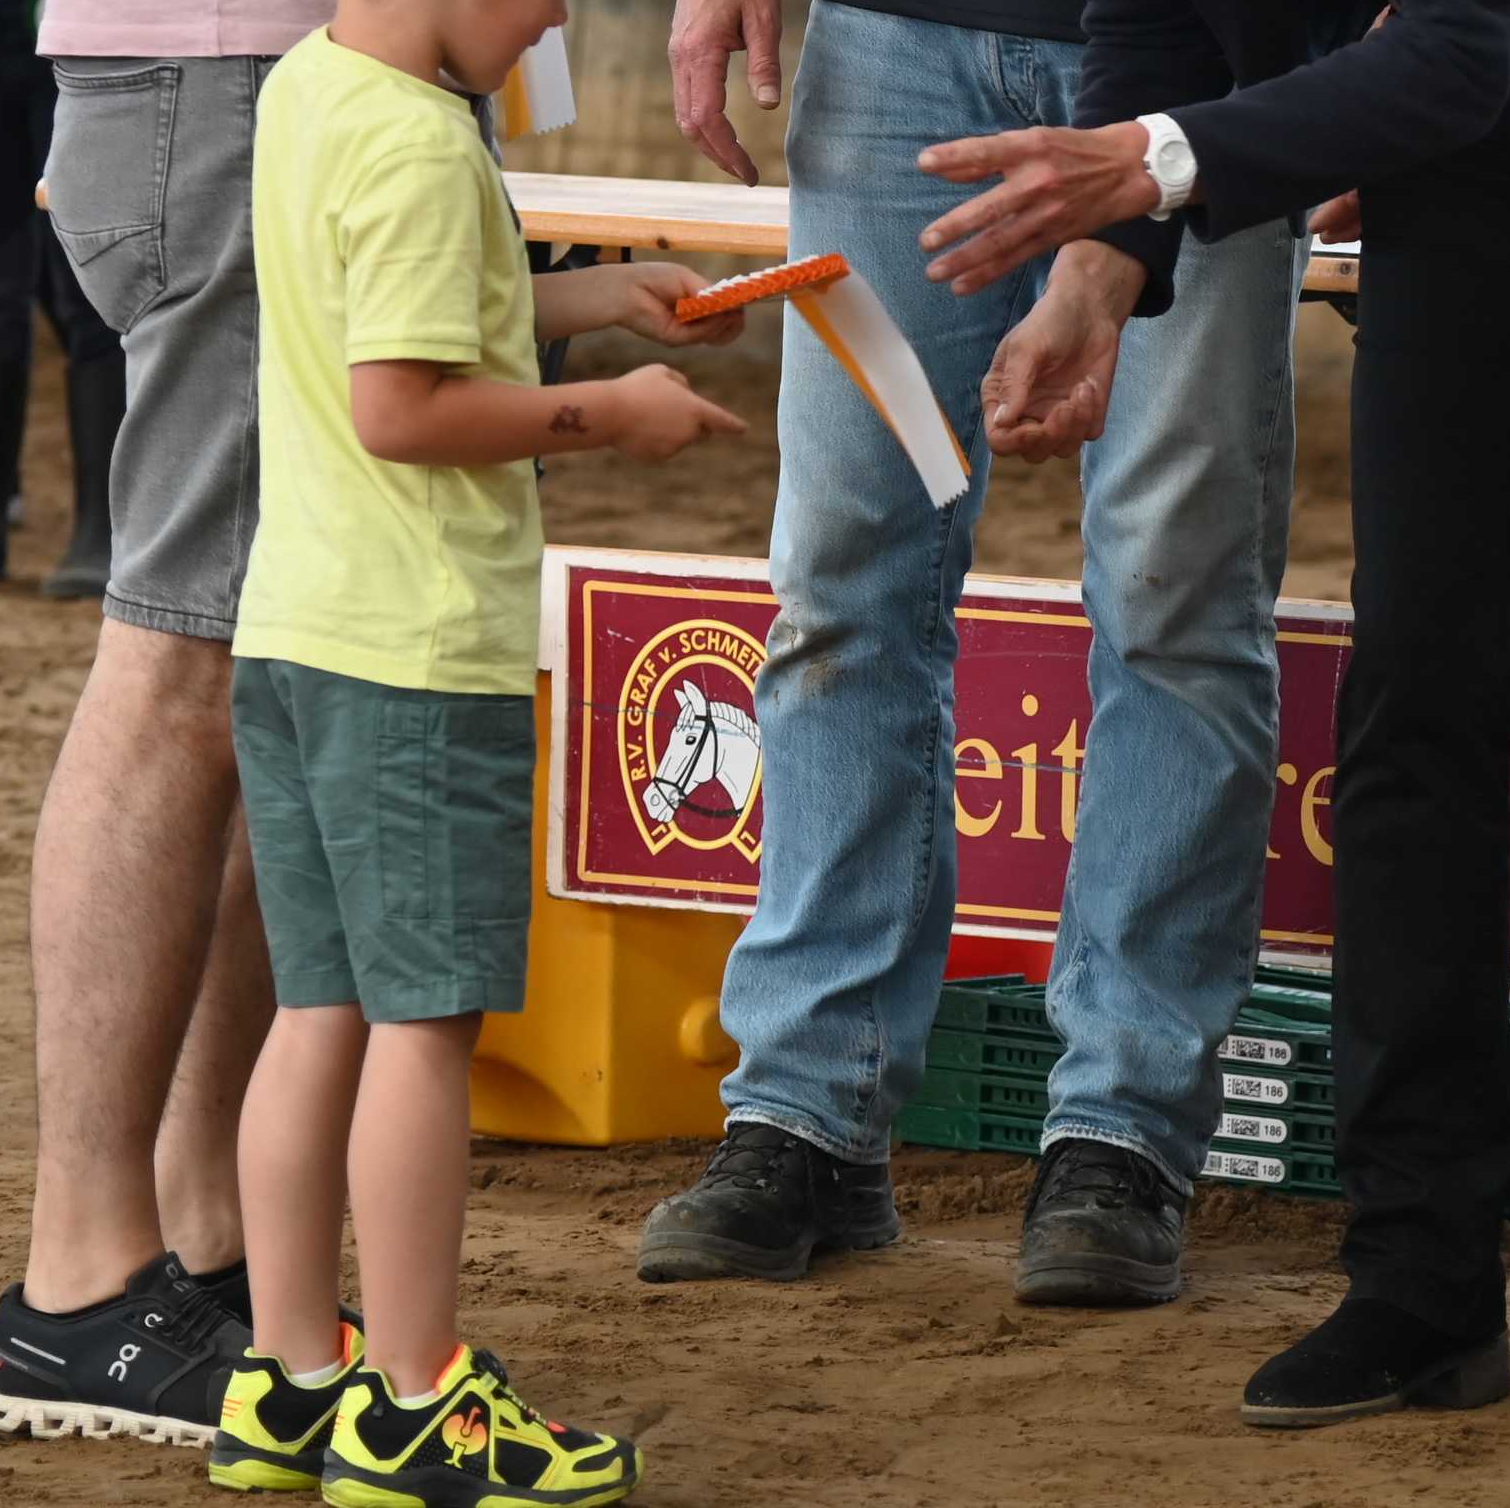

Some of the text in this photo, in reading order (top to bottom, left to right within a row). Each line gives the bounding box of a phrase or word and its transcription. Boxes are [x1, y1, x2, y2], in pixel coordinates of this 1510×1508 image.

[627, 661, 658, 726] GRAF
[1265, 1085, 1283, 1097] 186
[1264, 1125, 1282, 1137] 186
[1262, 1164, 1281, 1177] 186
